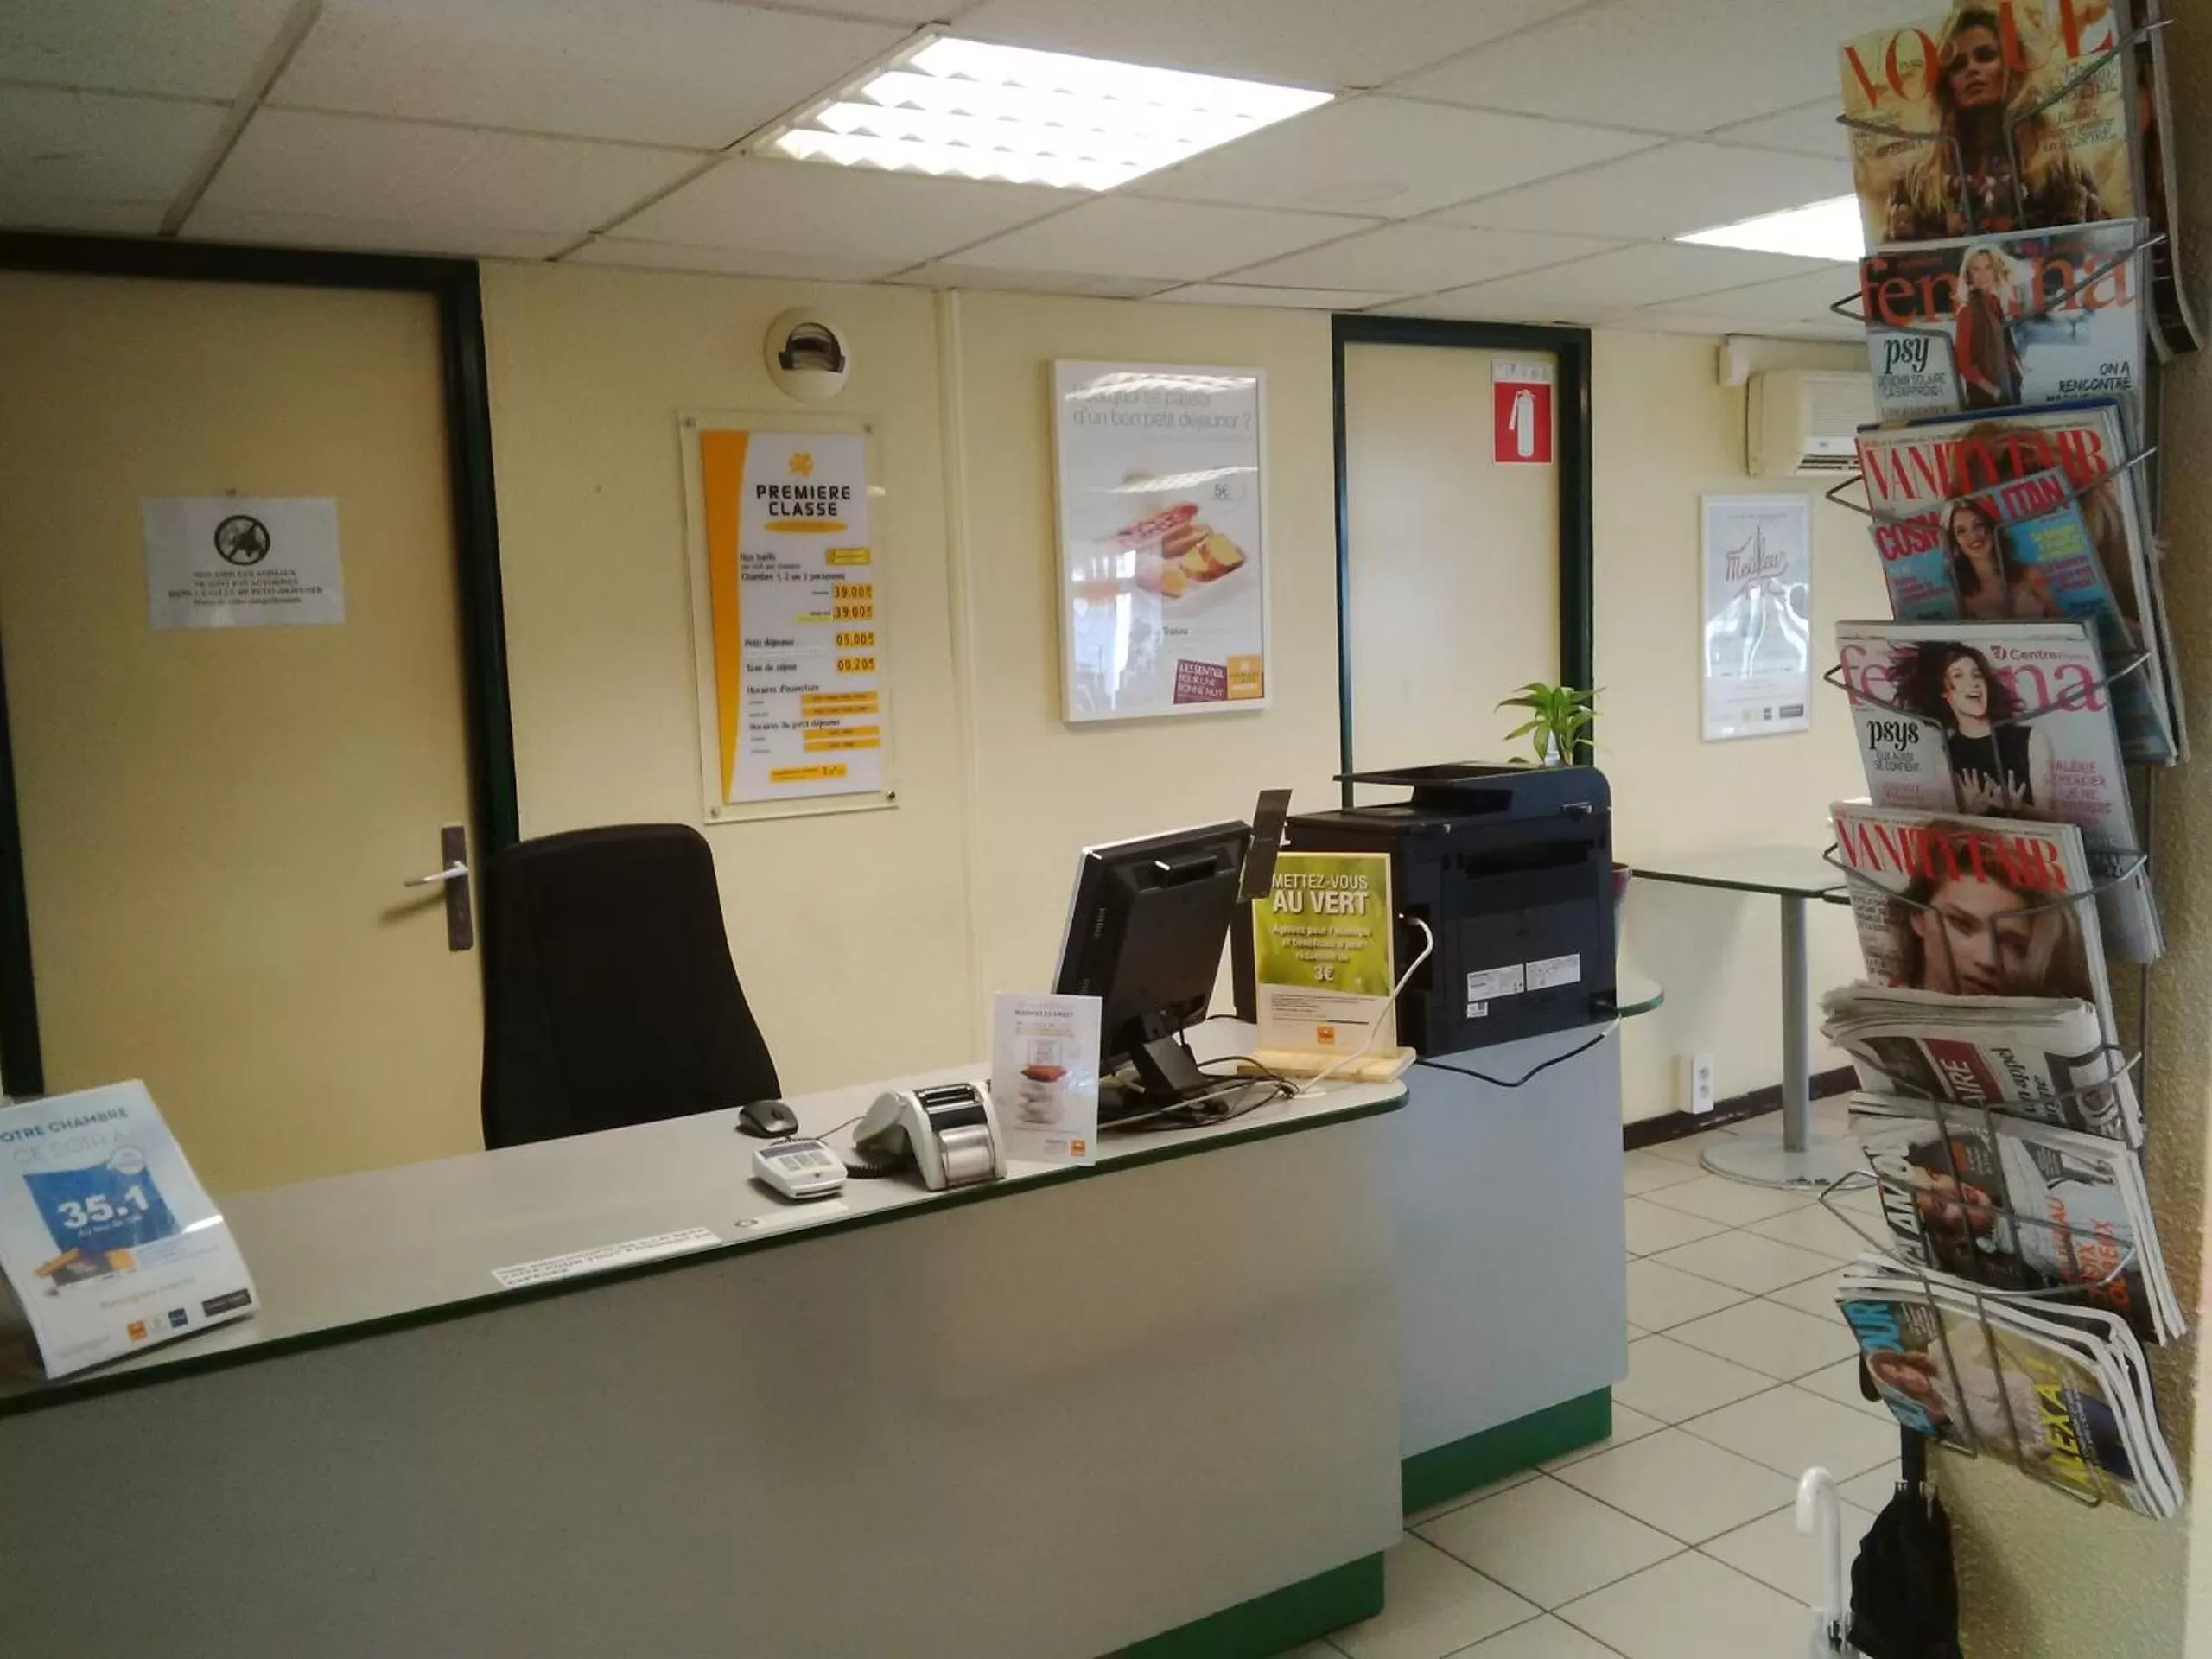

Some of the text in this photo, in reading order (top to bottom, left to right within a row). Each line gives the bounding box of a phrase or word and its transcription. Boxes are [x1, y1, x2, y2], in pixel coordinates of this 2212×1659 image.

[1843, 0, 2113, 108] VOUE
[1884, 336, 1929, 374] psy
[2100, 362, 2118, 376] ON
[755, 484, 851, 501] PREMIERE
[768, 501, 838, 517] CLASSE
[1867, 719, 1920, 752] psys
[1272, 873, 1369, 890] METTEZ-VOUS
[1274, 891, 1369, 916] AU VERT
[0, 1107, 129, 1143] OTRE CHAMBRE
